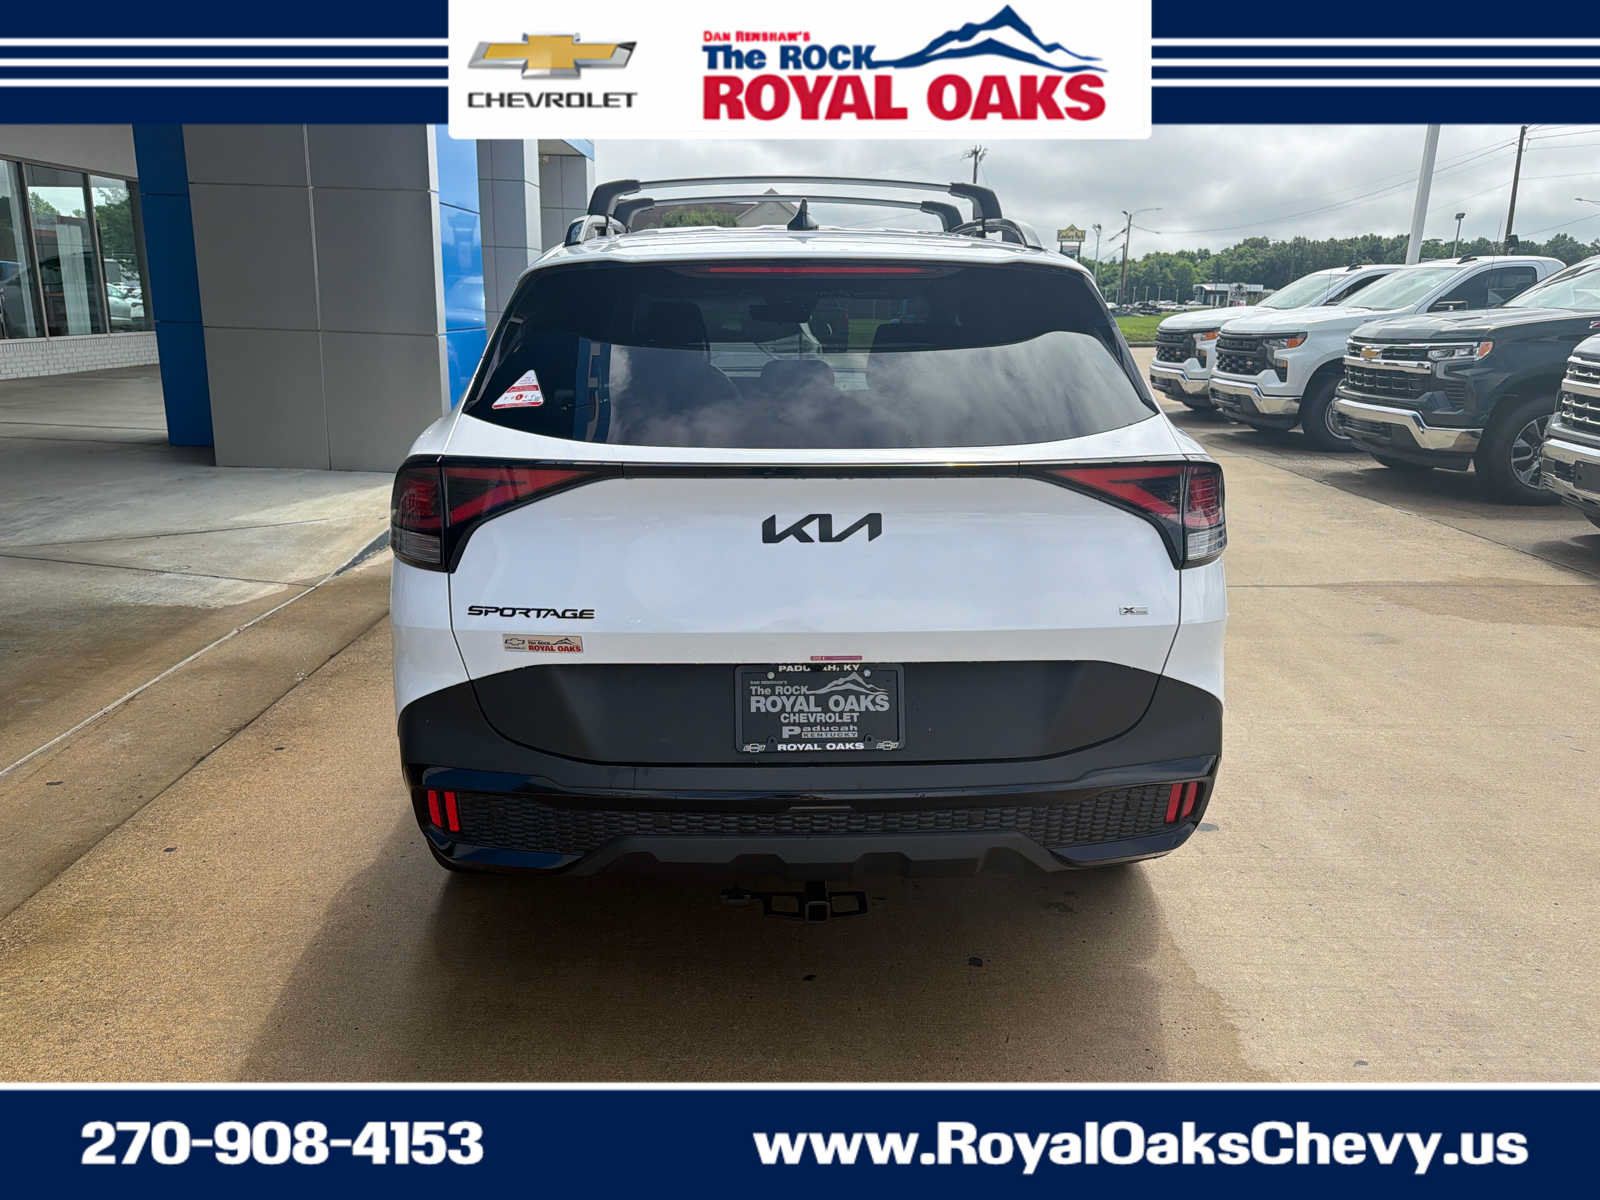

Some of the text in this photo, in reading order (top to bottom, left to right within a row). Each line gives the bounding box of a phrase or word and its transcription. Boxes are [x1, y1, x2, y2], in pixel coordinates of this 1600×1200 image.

[467, 605, 595, 619] SPORTAGE
[750, 685, 808, 695] The ROCK
[750, 695, 890, 712] ROYAL OAKS
[780, 712, 860, 723] CHEVROLET
[777, 742, 865, 751] ROYAL OAKS
